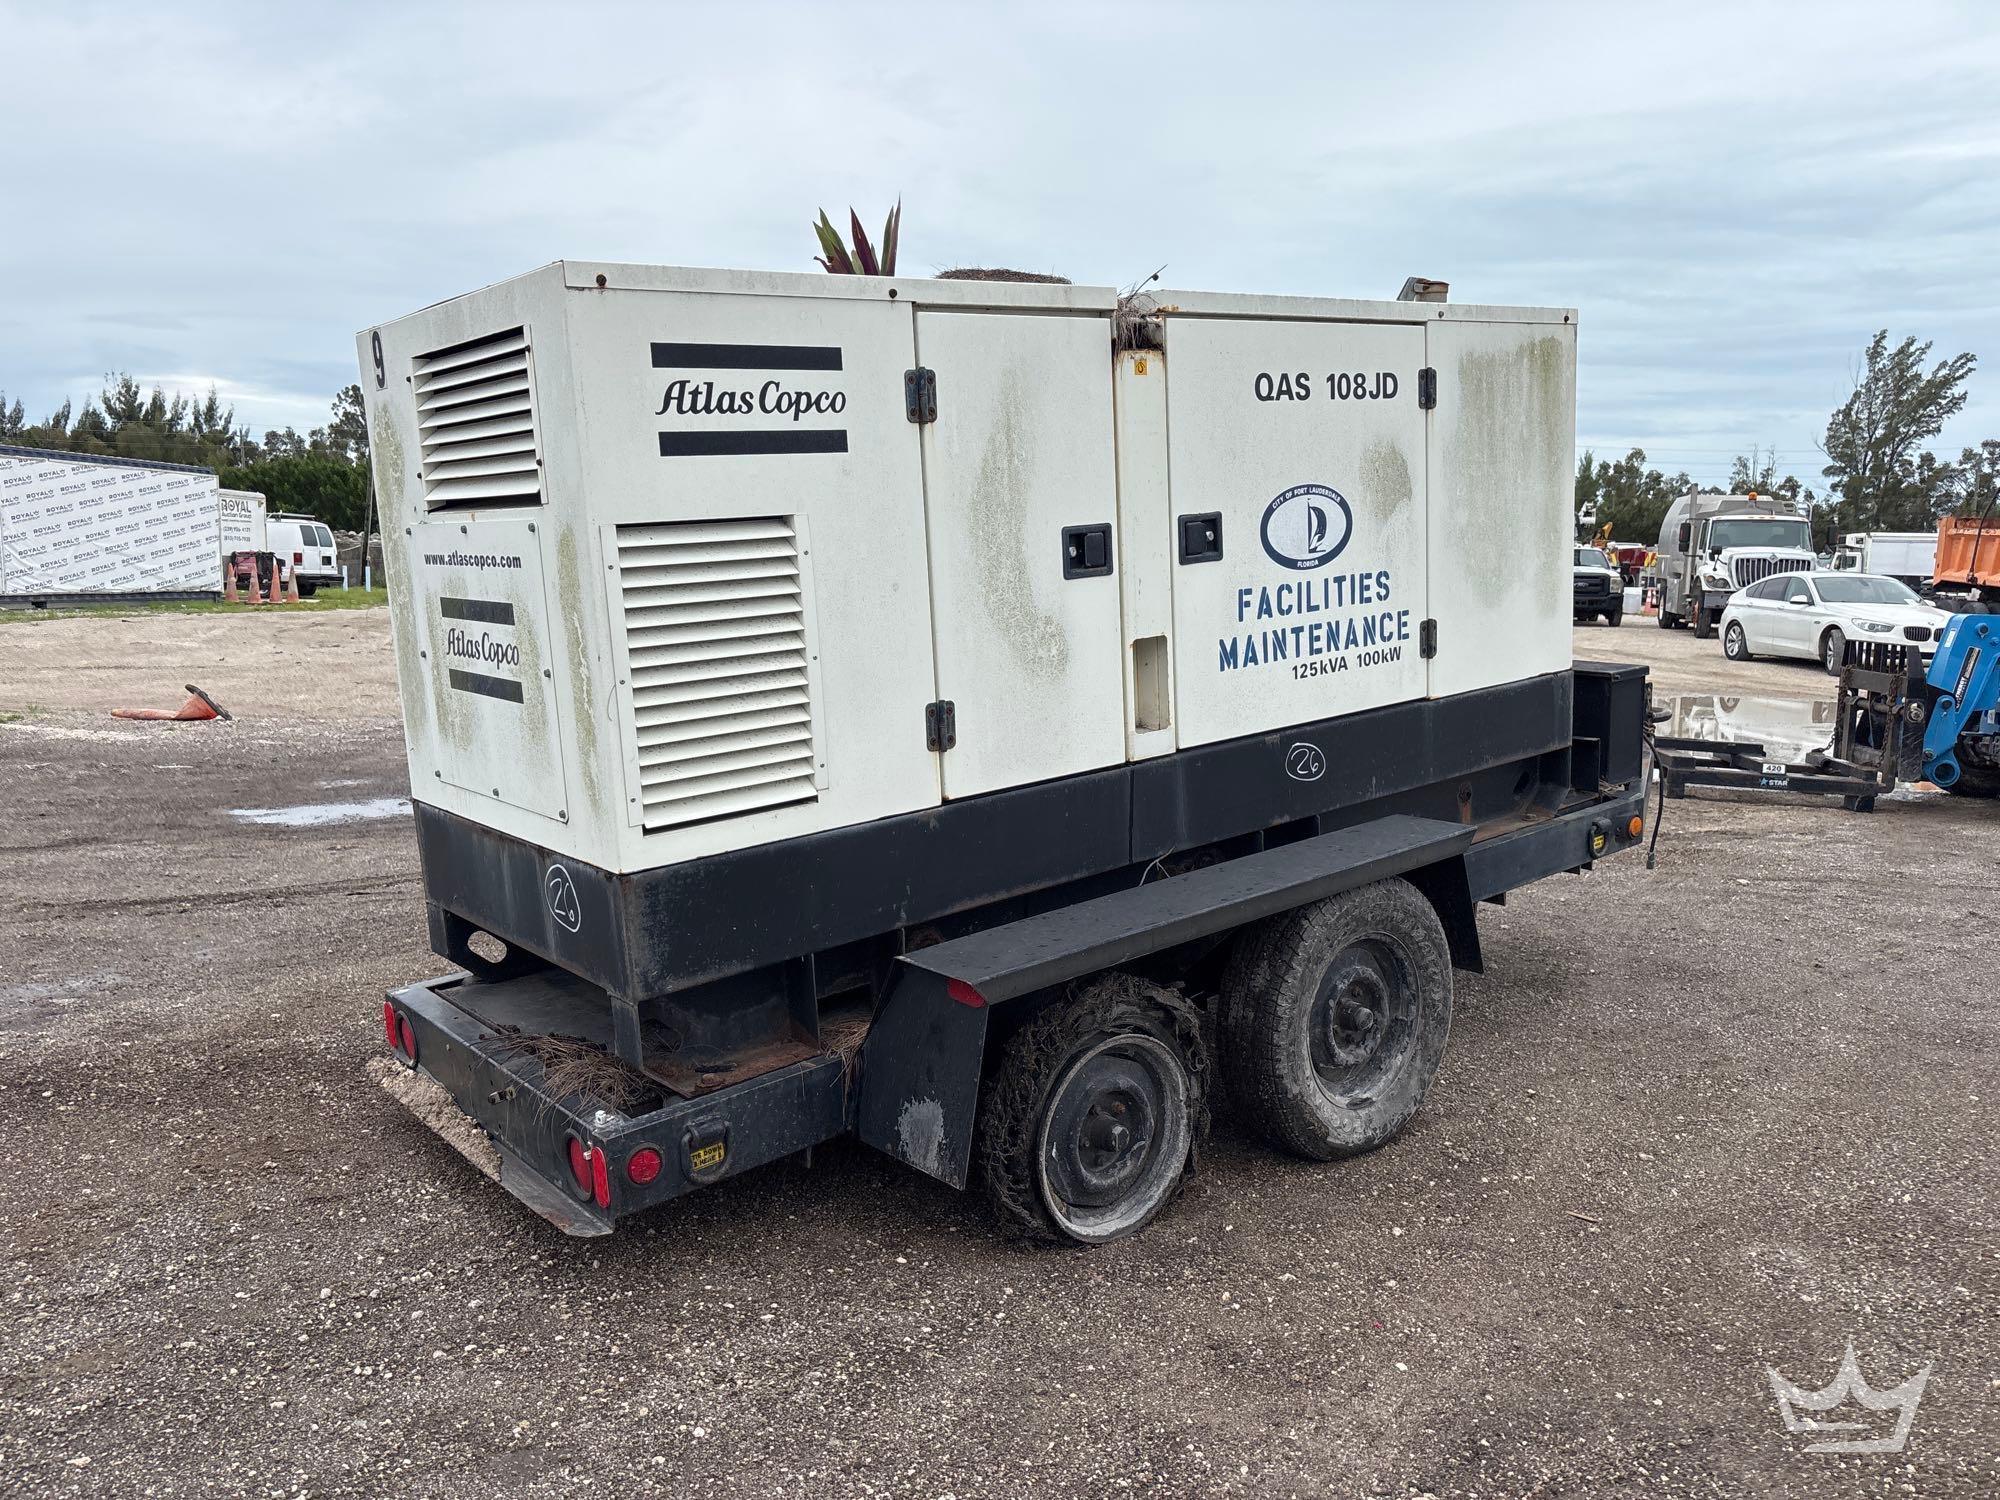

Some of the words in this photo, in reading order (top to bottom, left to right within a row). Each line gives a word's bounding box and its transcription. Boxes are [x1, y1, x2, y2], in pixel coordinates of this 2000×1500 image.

[372, 331, 385, 388] 9
[655, 380, 754, 415] Atlas
[759, 380, 846, 421] Copco
[1254, 372, 1311, 401] QAS
[1325, 372, 1399, 400] 108JD
[221, 499, 252, 513] ROYAL
[1272, 496, 1284, 509] CITY
[1286, 492, 1293, 500] OF
[1294, 488, 1308, 496] FORT
[1309, 486, 1342, 504] LAUDERDALE
[424, 550, 522, 571] www.atlascopco.com
[1298, 560, 1318, 568] FLORIDA
[1237, 570, 1391, 623] FACILITIES
[446, 628, 480, 660] Atlas
[482, 631, 520, 670] Copco
[1218, 609, 1410, 672] MAINTENANCE
[1291, 656, 1349, 680] 125kVA
[1356, 646, 1402, 668] 100kW
[1290, 748, 1319, 774] 26
[550, 878, 575, 922] 26
[704, 1144, 722, 1156] DOWN
